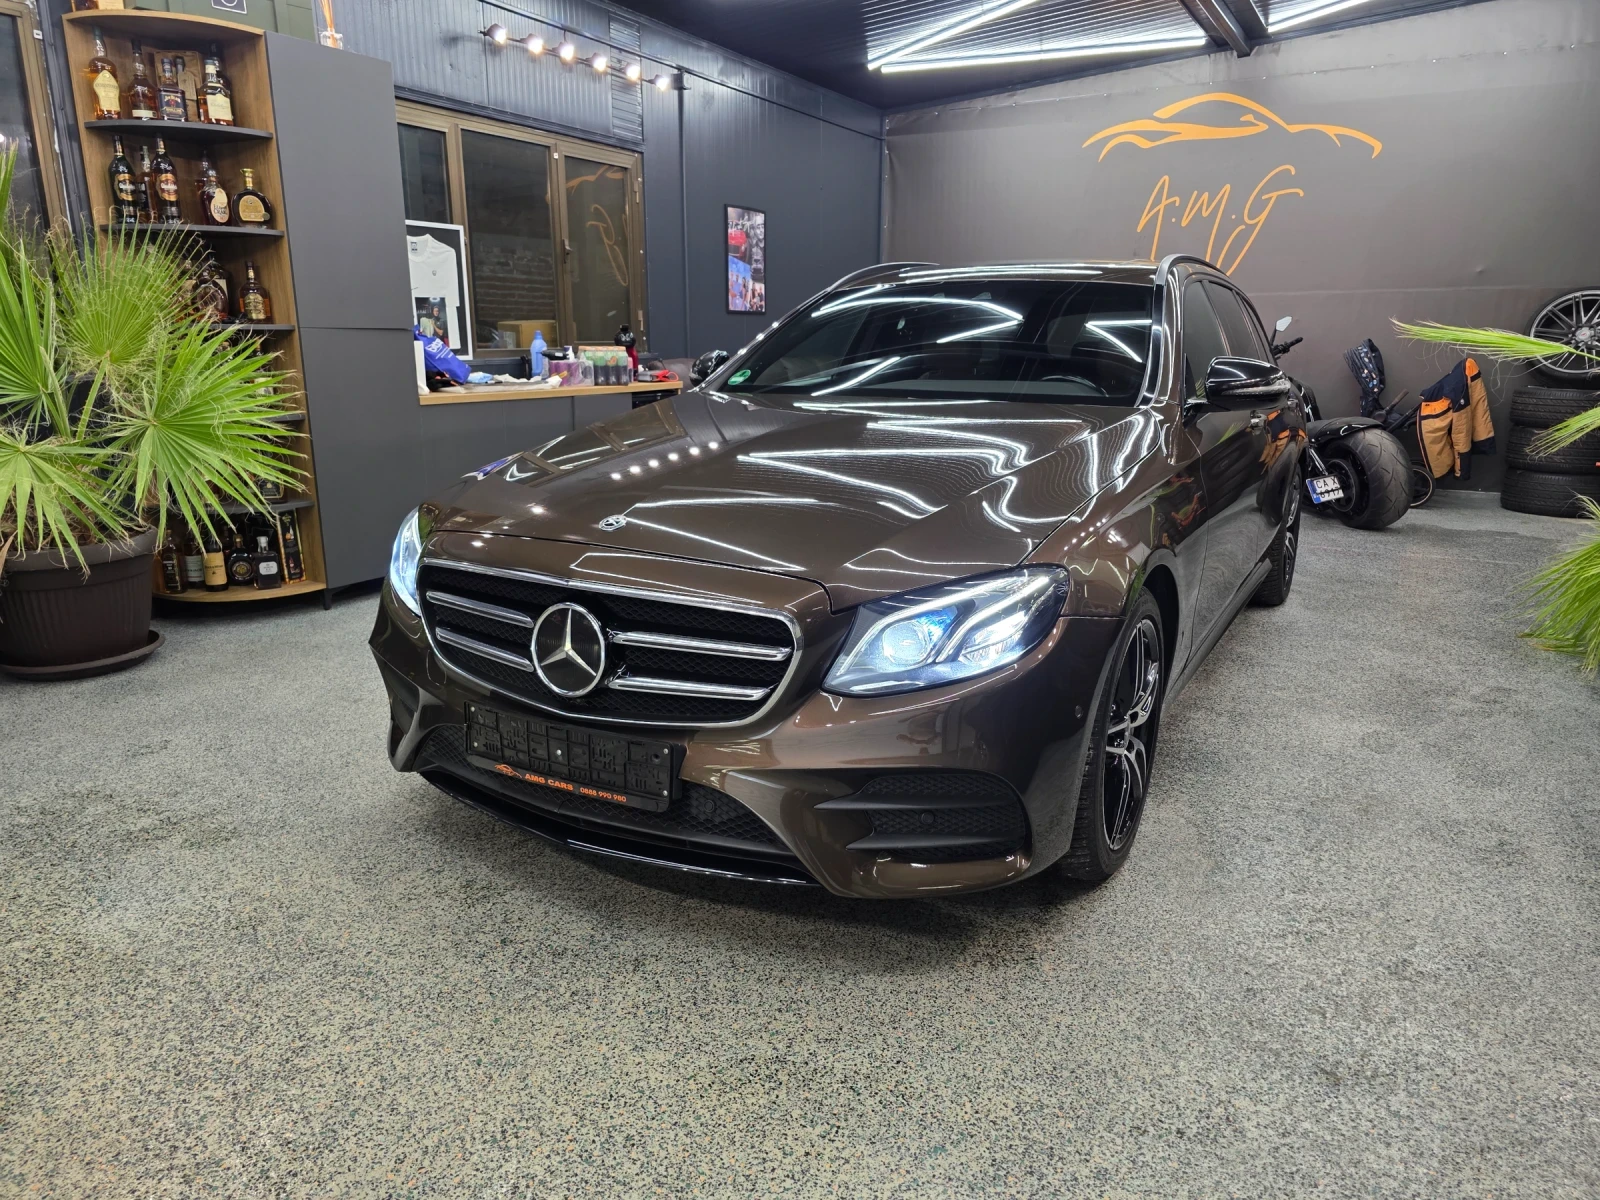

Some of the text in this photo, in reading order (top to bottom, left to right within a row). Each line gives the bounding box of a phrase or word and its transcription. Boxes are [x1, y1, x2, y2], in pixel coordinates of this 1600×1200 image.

[524, 773, 574, 791] AMG CARS
[580, 787, 597, 796] 0888
[598, 791, 612, 799] 990
